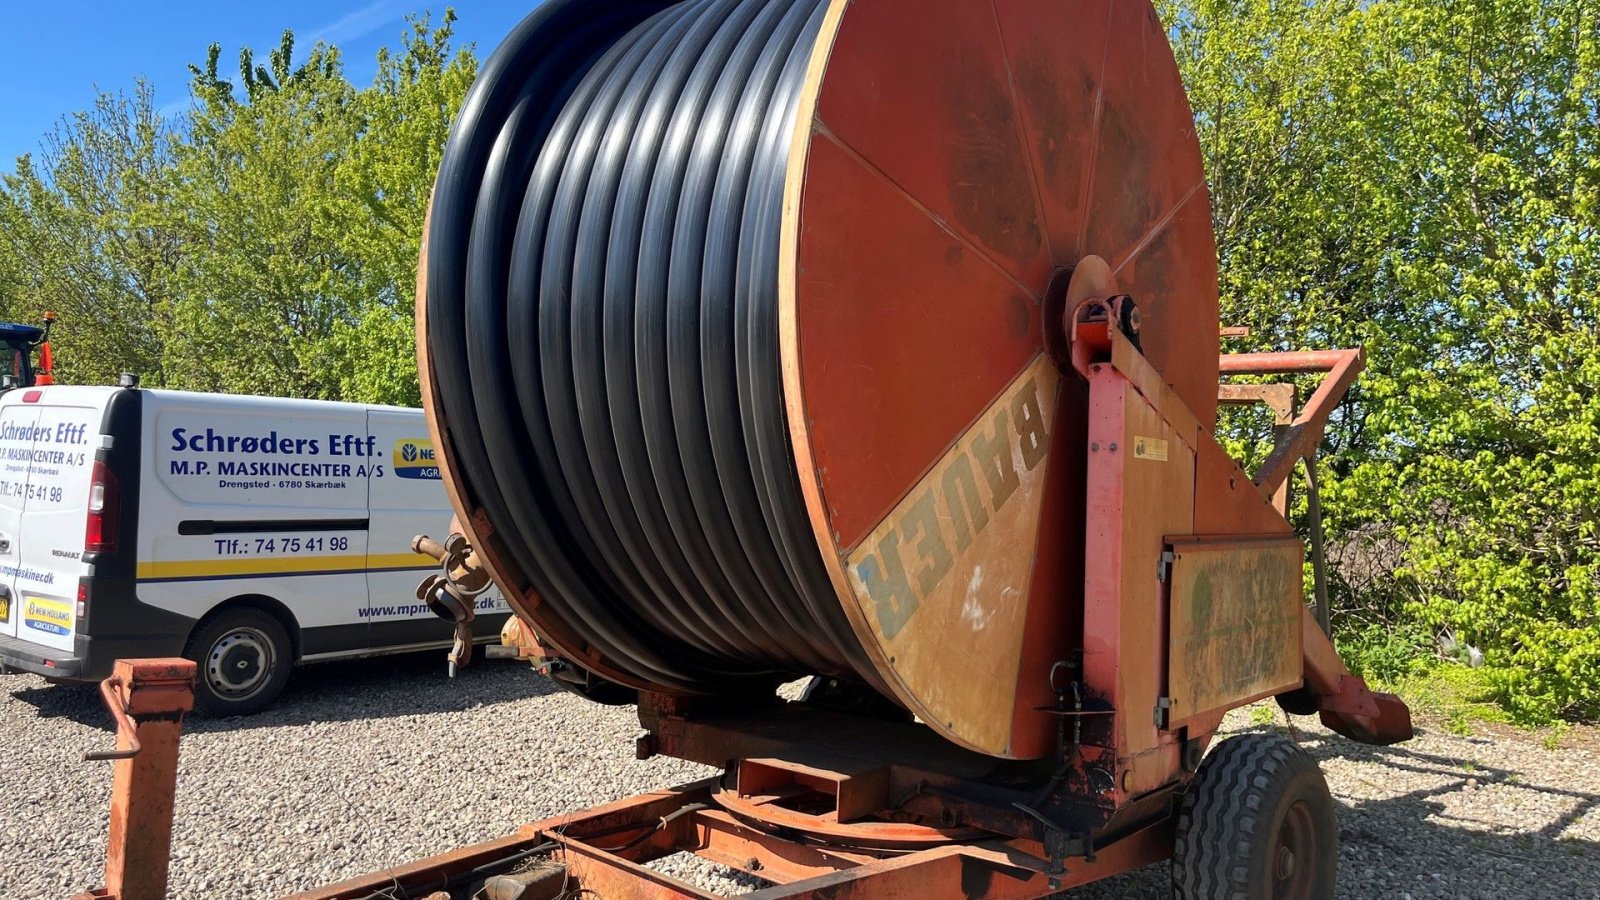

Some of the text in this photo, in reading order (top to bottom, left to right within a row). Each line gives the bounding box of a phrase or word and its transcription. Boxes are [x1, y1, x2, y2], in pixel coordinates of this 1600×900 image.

[0, 420, 87, 445] Schrøders Eftf.
[171, 428, 383, 457] Schrøders Eftf.
[8, 448, 64, 465] MASKINCENTER
[66, 452, 85, 467] A/S
[420, 449, 435, 460] NE
[171, 461, 384, 479] M.P. MASKINCENTER A/S
[13, 483, 22, 497] 74
[25, 484, 35, 499] 75
[36, 485, 47, 500] 41
[50, 486, 62, 502] 98
[219, 480, 346, 489] Drengsted 6780 Skærbæk
[857, 376, 1049, 640] BAUER
[215, 537, 348, 554] Tlf.: 74 75 41 98
[47, 609, 70, 621] HOLLAND
